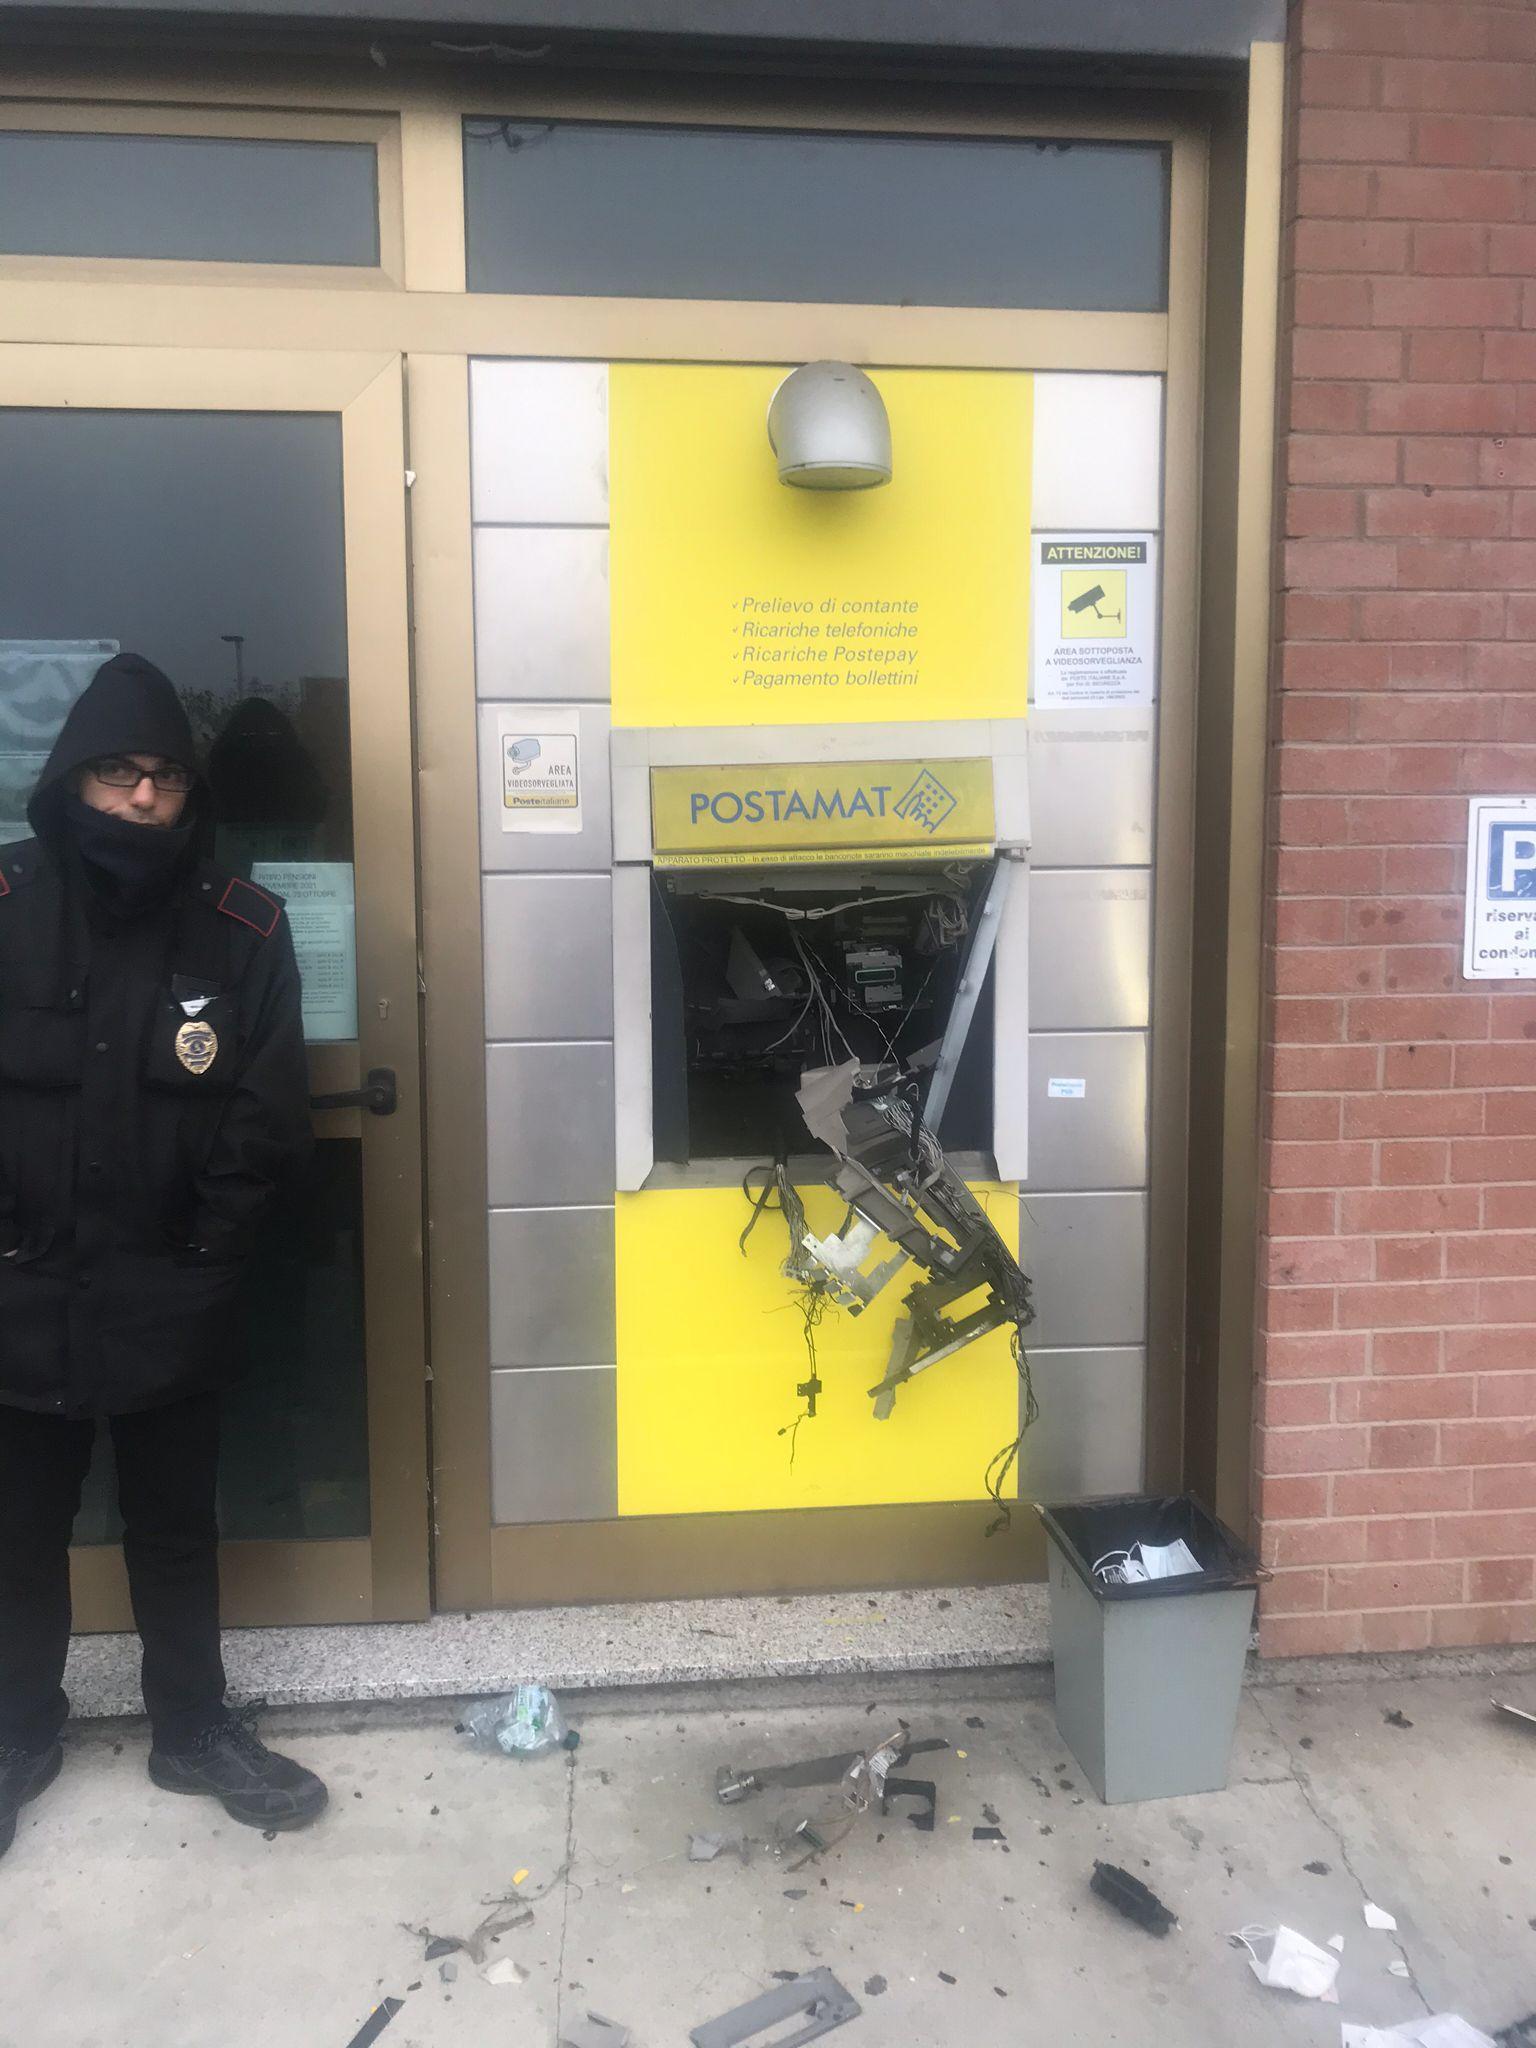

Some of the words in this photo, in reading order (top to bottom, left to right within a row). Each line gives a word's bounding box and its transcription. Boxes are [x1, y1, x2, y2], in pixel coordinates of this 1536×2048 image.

[1047, 546, 1141, 559] ATTENZIONE!
[742, 597, 814, 613] Prelievo
[819, 597, 836, 613] di
[841, 599, 919, 613] contante
[742, 622, 820, 638] Ricariche
[826, 622, 918, 638] telefoniche
[742, 646, 828, 662] Ricariche
[833, 646, 918, 665] Postepay
[1079, 647, 1134, 655] SOTTOPOSTA
[1053, 657, 1142, 665] VIDEOSORVEGLIANZA
[742, 670, 840, 689] Pagamento
[845, 670, 919, 686] bollettini
[548, 764, 572, 776] AREA
[507, 779, 574, 788] VIDEOSORVEGLIATA
[690, 786, 892, 824] POSTAMAT
[657, 856, 699, 864] APPARATO
[701, 856, 745, 864] PROTETTO
[1502, 830, 1536, 892] P
[1514, 927, 1530, 940] ai
